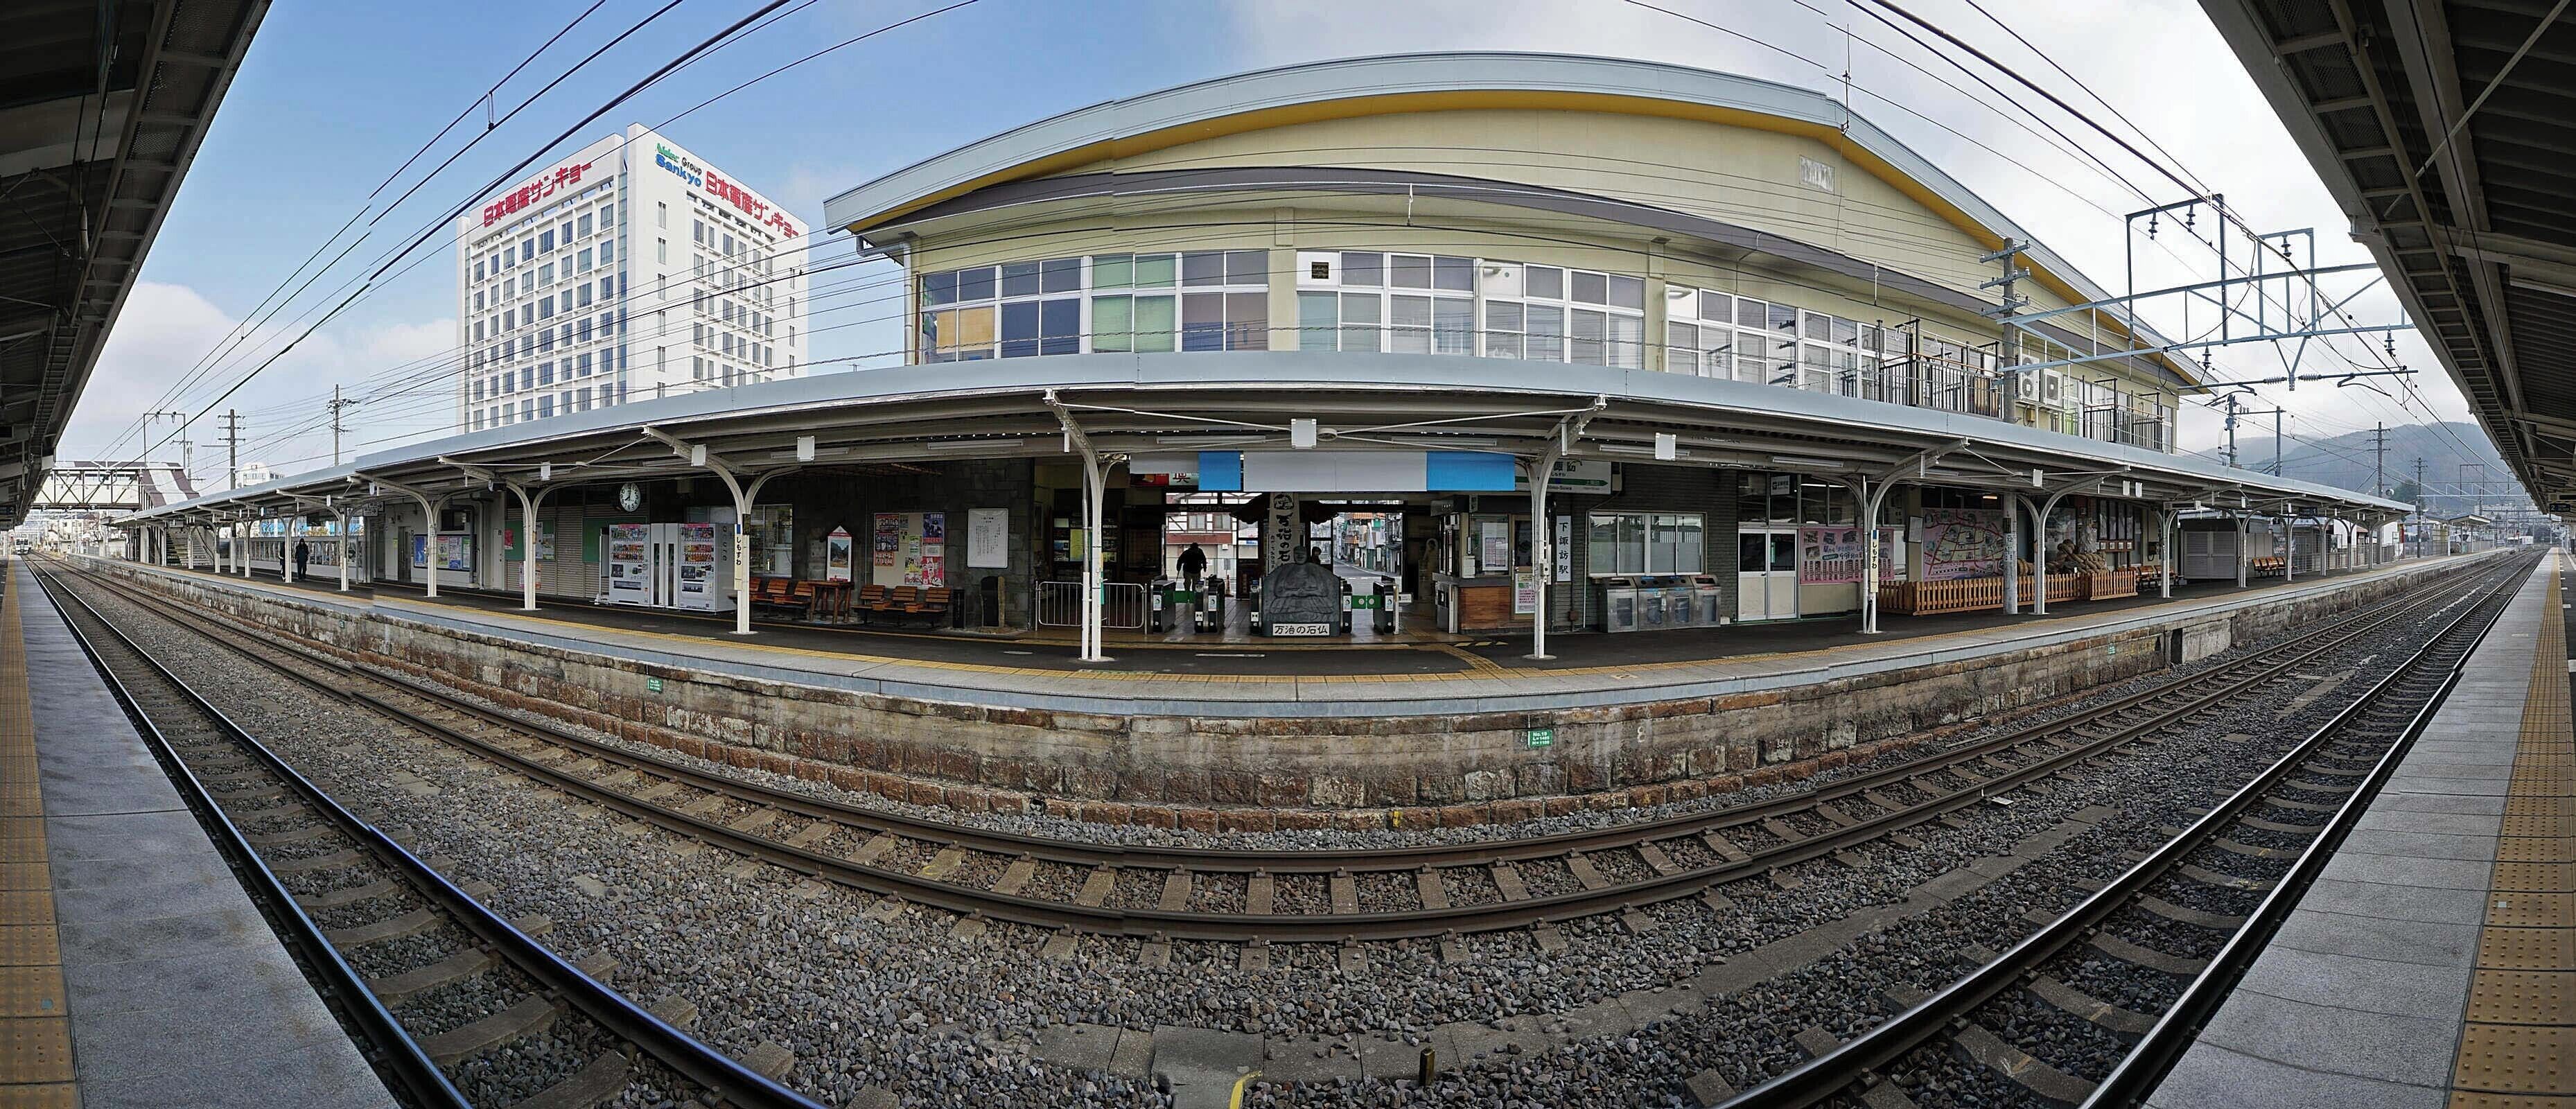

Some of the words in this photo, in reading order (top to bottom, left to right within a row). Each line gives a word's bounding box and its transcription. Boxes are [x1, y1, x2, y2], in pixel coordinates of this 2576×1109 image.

[655, 153, 702, 187] Sankyo
[681, 157, 702, 176] Group
[484, 161, 592, 227] 日本電産サンキョー
[706, 171, 799, 238] 日本電産サンキョー
[1276, 512, 1293, 566] 万治の石
[1559, 522, 1568, 573] 下諏訪駅
[1274, 625, 1328, 634] 万治の石仏
